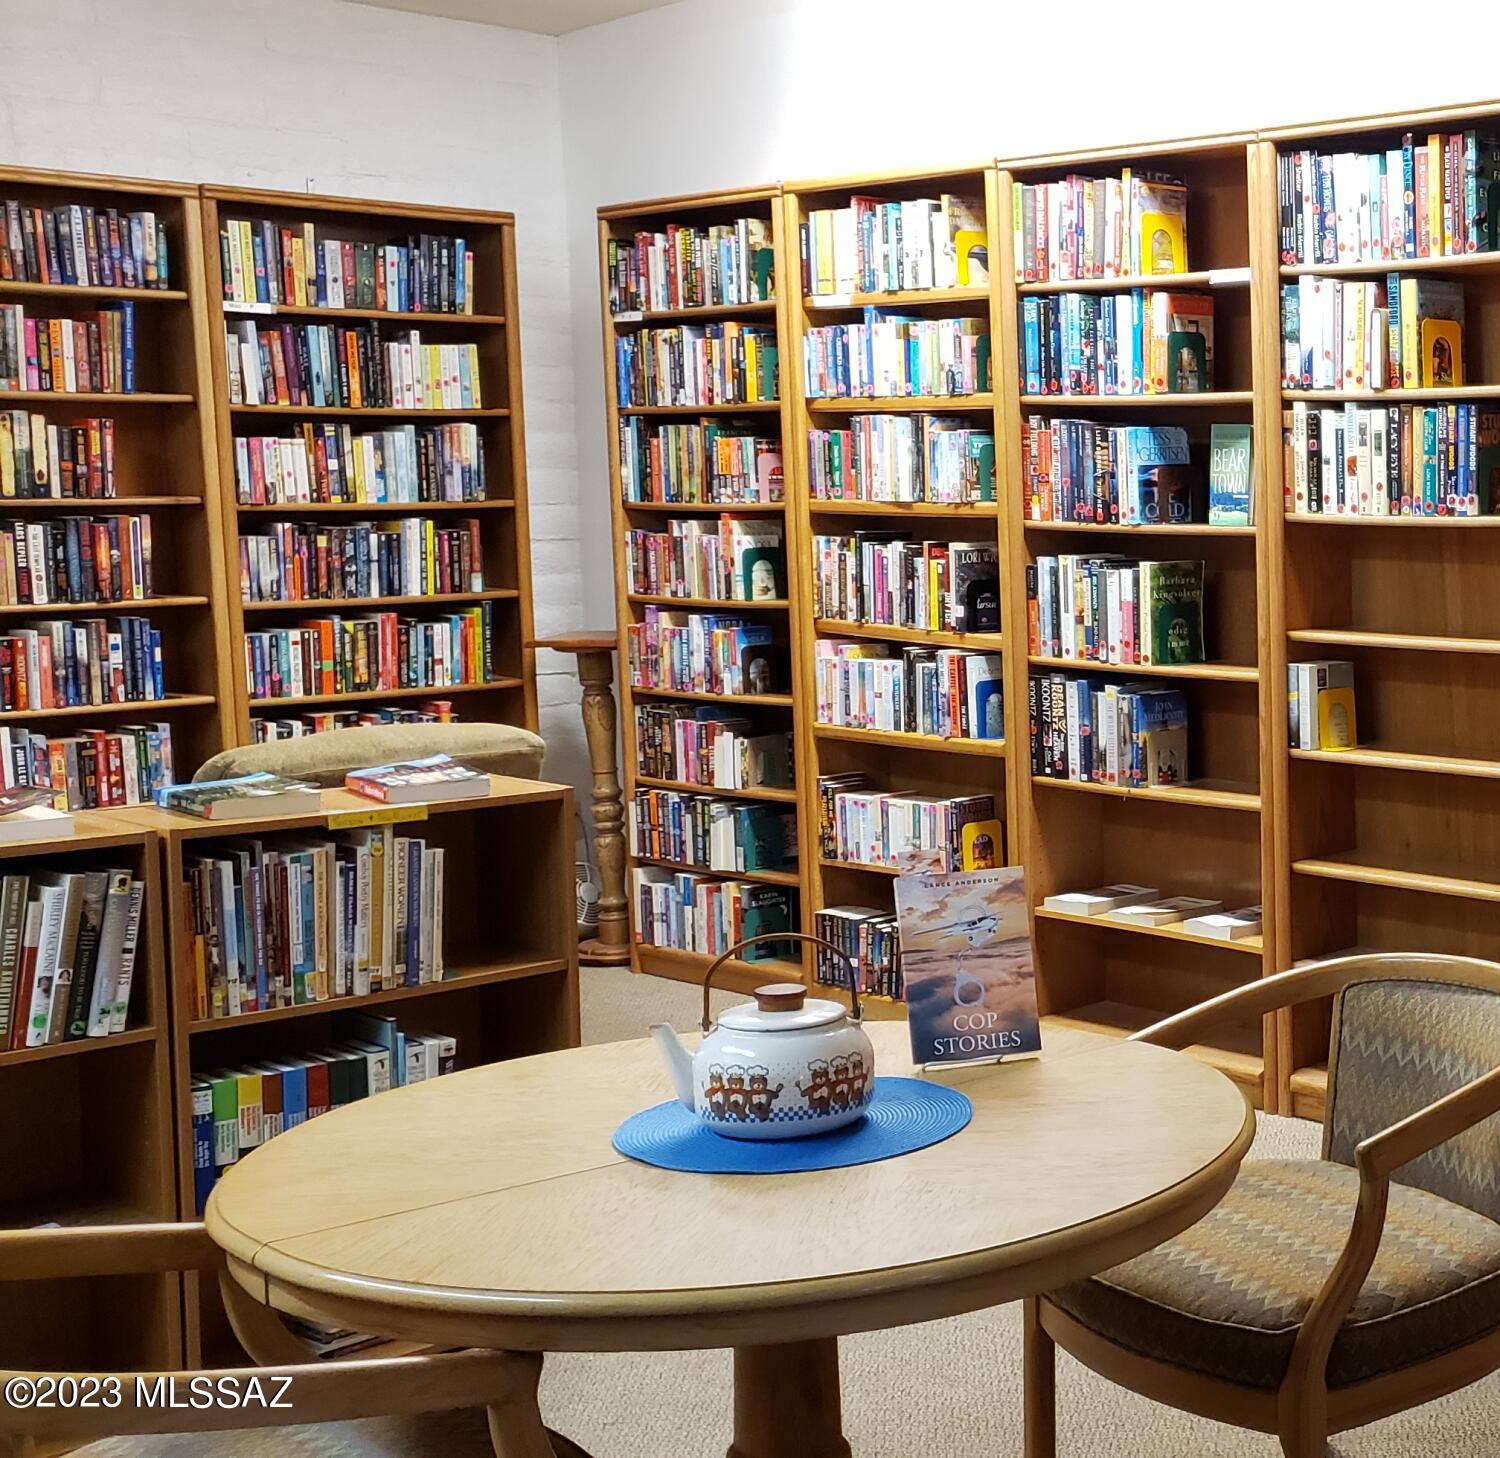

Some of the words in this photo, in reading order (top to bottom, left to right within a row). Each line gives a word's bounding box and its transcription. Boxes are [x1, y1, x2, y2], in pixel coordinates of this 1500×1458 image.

[1389, 286, 1398, 325] SANDFORD
[1146, 431, 1173, 446] TESS
[1214, 449, 1247, 472] BEAR
[1469, 444, 1477, 471] WOODS
[1213, 473, 1247, 493] TOWN
[16, 522, 25, 539] LARS
[17, 541, 26, 566] KEPLER
[962, 551, 981, 563] LORI
[1042, 683, 1051, 723] KOONTZ
[1051, 684, 1059, 730] KOONTZ
[1057, 685, 1065, 716] DEAN
[359, 854, 369, 879] Cowboy
[955, 877, 999, 886] ANDERSON
[48, 893, 63, 928] SHIRLEY
[128, 888, 141, 914] DENNIS
[123, 916, 138, 942] MILLER
[3, 928, 17, 966] CHARLES
[119, 958, 132, 986] RANTS
[953, 1012, 998, 1032] COP
[934, 1031, 1021, 1055] STORIES
